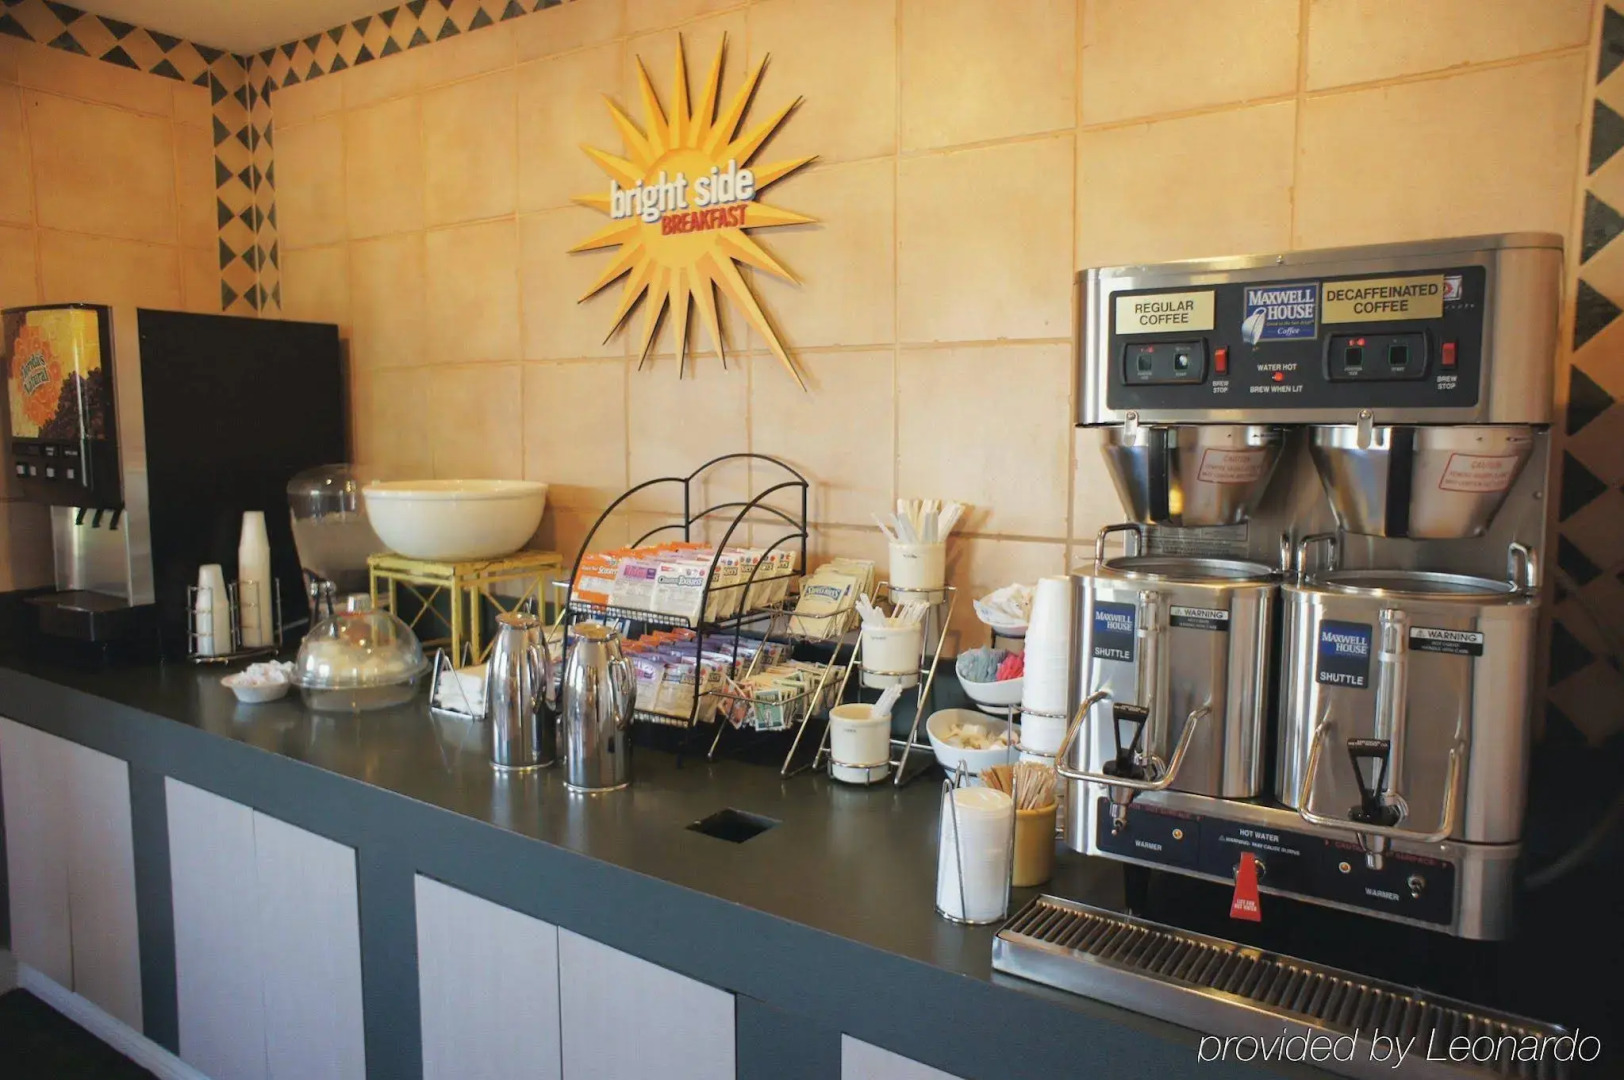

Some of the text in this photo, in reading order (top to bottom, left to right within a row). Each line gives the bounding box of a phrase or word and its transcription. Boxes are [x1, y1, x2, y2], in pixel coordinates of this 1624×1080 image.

[611, 159, 755, 223] bright side
[661, 204, 748, 236] BREAKFAST
[1248, 288, 1314, 306] MAXWELL
[1326, 283, 1438, 302] DECAFFEINATED
[1134, 300, 1194, 314] REGULAR
[1267, 303, 1314, 320] HOUSE
[1353, 299, 1408, 314] COFFEE
[1139, 312, 1189, 326] COFFEE
[1277, 326, 1300, 337] Coffee
[1212, 380, 1229, 388] BREW
[1437, 375, 1458, 383] BREW
[1271, 385, 1292, 393] WHEN
[1293, 385, 1303, 393] LIT
[1096, 610, 1132, 624] MAXWELL
[1185, 608, 1224, 619] WARNING
[1106, 621, 1132, 632] HOUSE
[1321, 631, 1367, 646] MAXWELL
[1427, 630, 1477, 642] WARNING
[1094, 646, 1130, 659] SHUTTLE
[1335, 643, 1367, 655] HOUSE
[1320, 671, 1364, 686] SHUTTLE
[1239, 829, 1279, 842] HOT WATER
[1134, 839, 1163, 851] WARMER
[1365, 887, 1400, 901] WARMER
